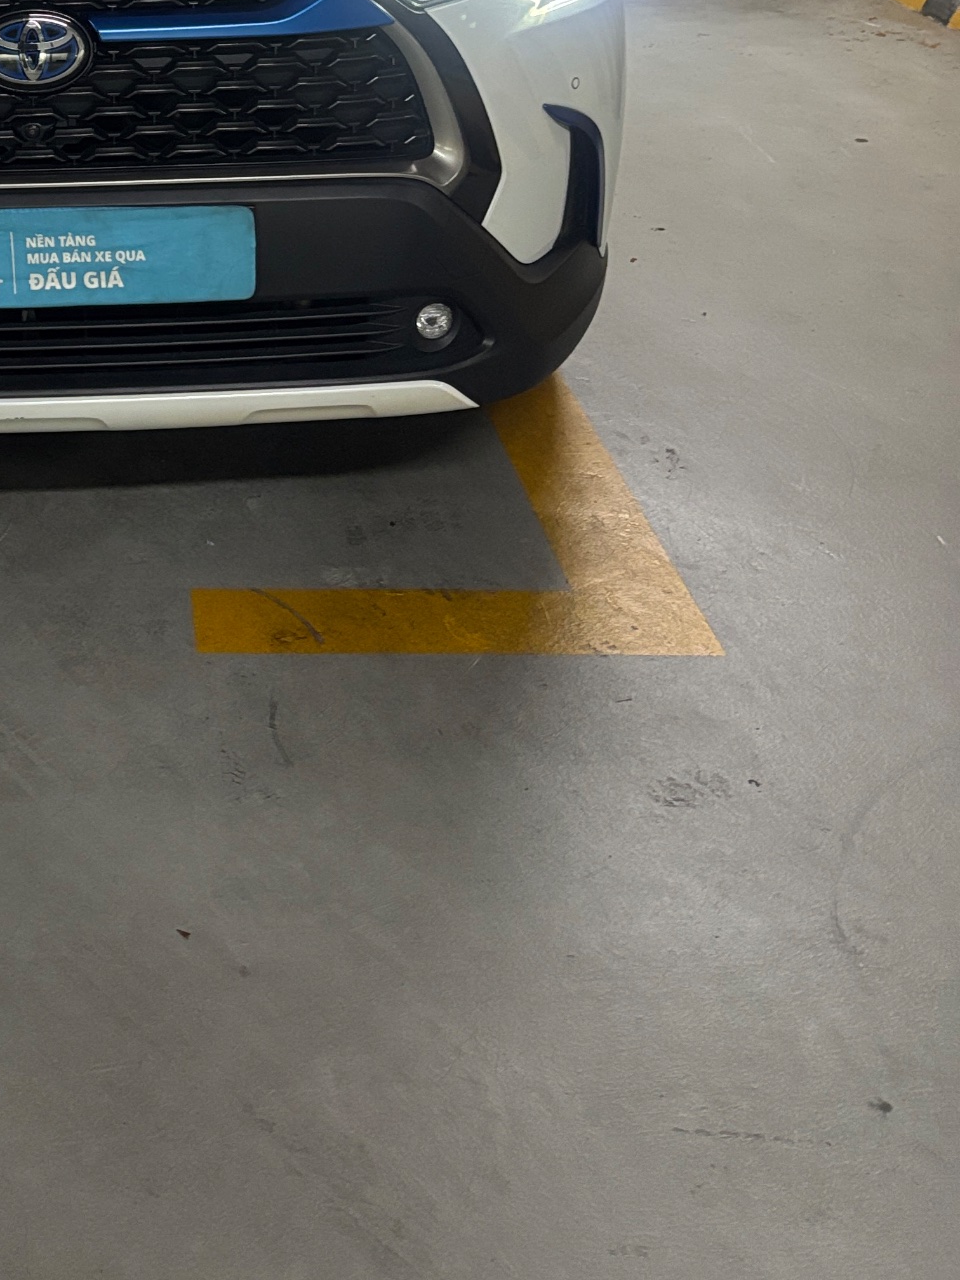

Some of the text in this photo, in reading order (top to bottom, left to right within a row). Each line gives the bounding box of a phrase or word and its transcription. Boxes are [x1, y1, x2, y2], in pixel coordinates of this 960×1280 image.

[25, 233, 55, 248] NỀN
[27, 249, 146, 264] MUA BÁN XE QUA
[29, 266, 124, 291] ĐẤU GIÁ
